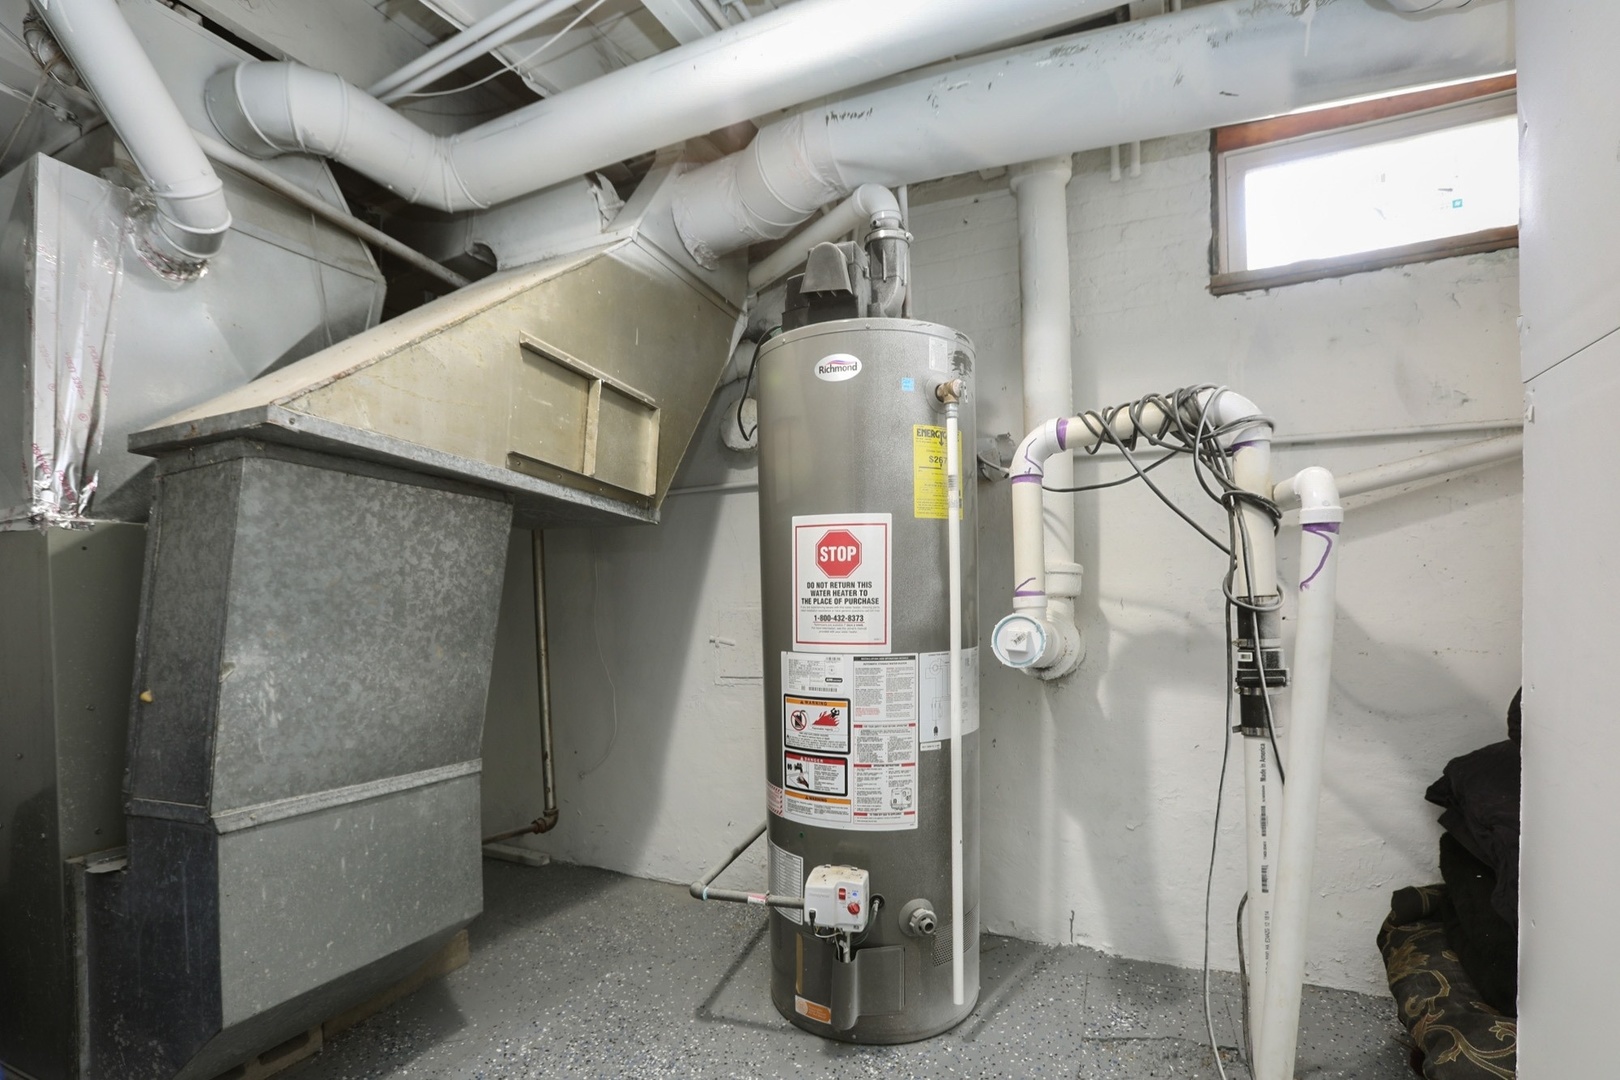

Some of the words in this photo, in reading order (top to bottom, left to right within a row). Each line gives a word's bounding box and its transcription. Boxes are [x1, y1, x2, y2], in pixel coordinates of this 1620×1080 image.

[818, 362, 858, 375] Richmond
[820, 545, 857, 562] STOP
[829, 581, 856, 589] RETURN
[857, 581, 872, 589] THIS
[832, 589, 858, 597] HEATER
[859, 589, 868, 597] TO
[844, 597, 880, 605] PURCHASE
[814, 614, 864, 622] 1-800-432-8373
